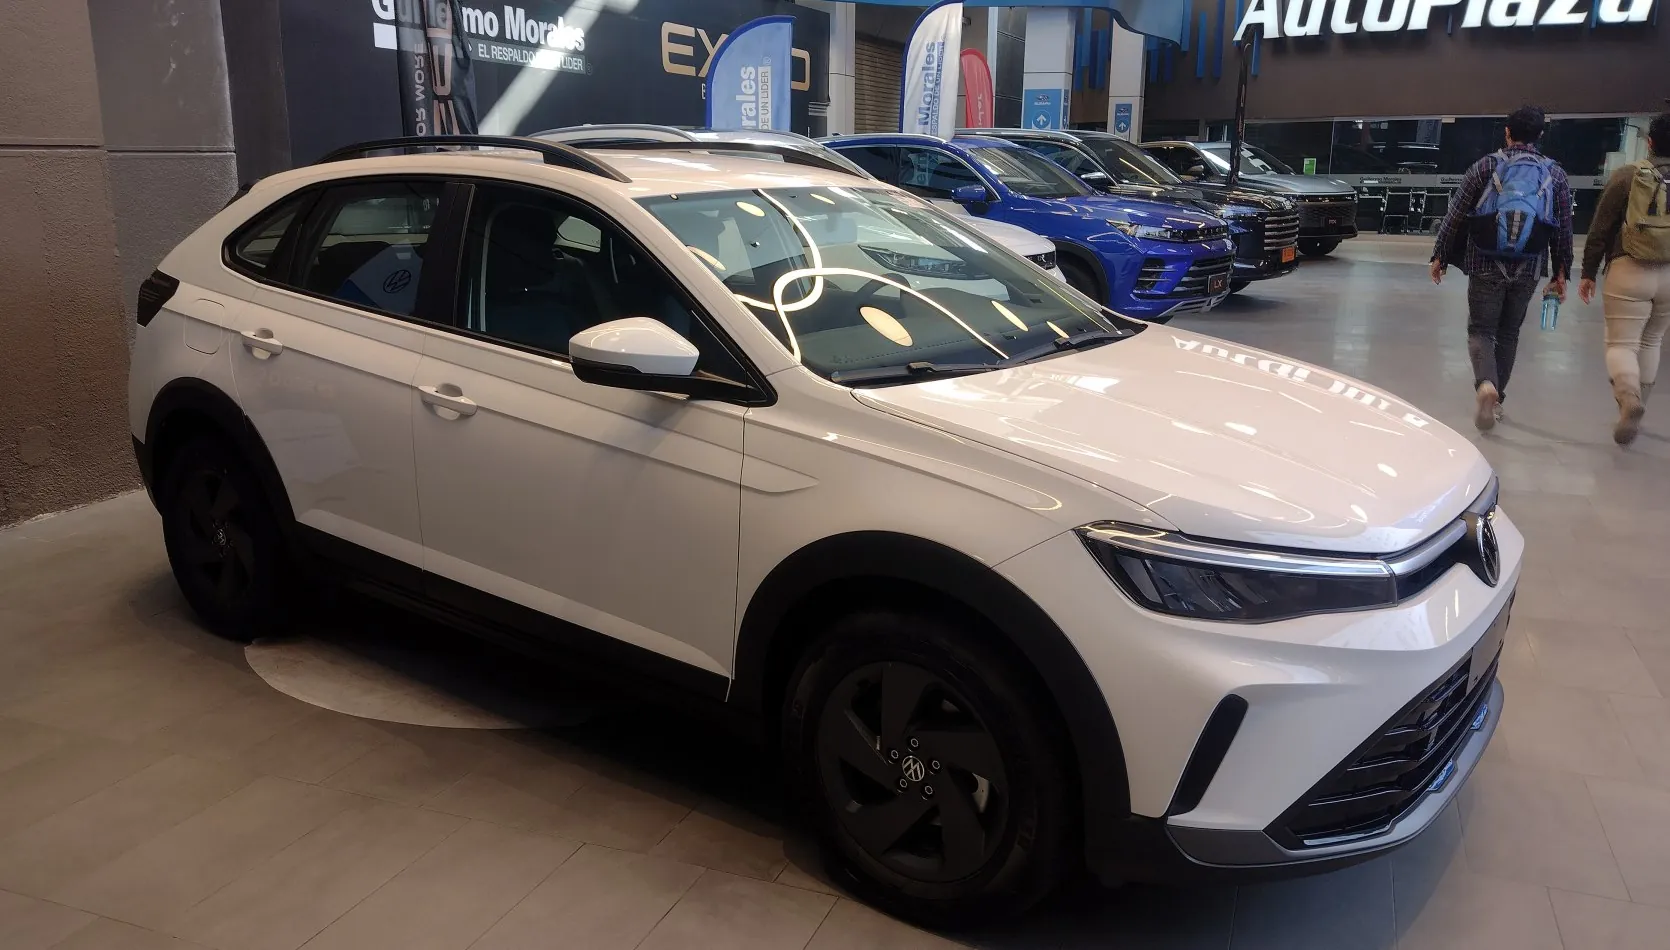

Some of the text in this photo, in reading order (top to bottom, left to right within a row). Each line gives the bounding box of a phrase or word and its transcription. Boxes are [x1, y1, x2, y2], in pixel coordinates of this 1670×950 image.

[478, 43, 490, 59] EL
[491, 46, 536, 65] RESPALDO
[917, 41, 936, 126] Morales
[760, 101, 770, 116] UN
[1213, 279, 1223, 289] LX
